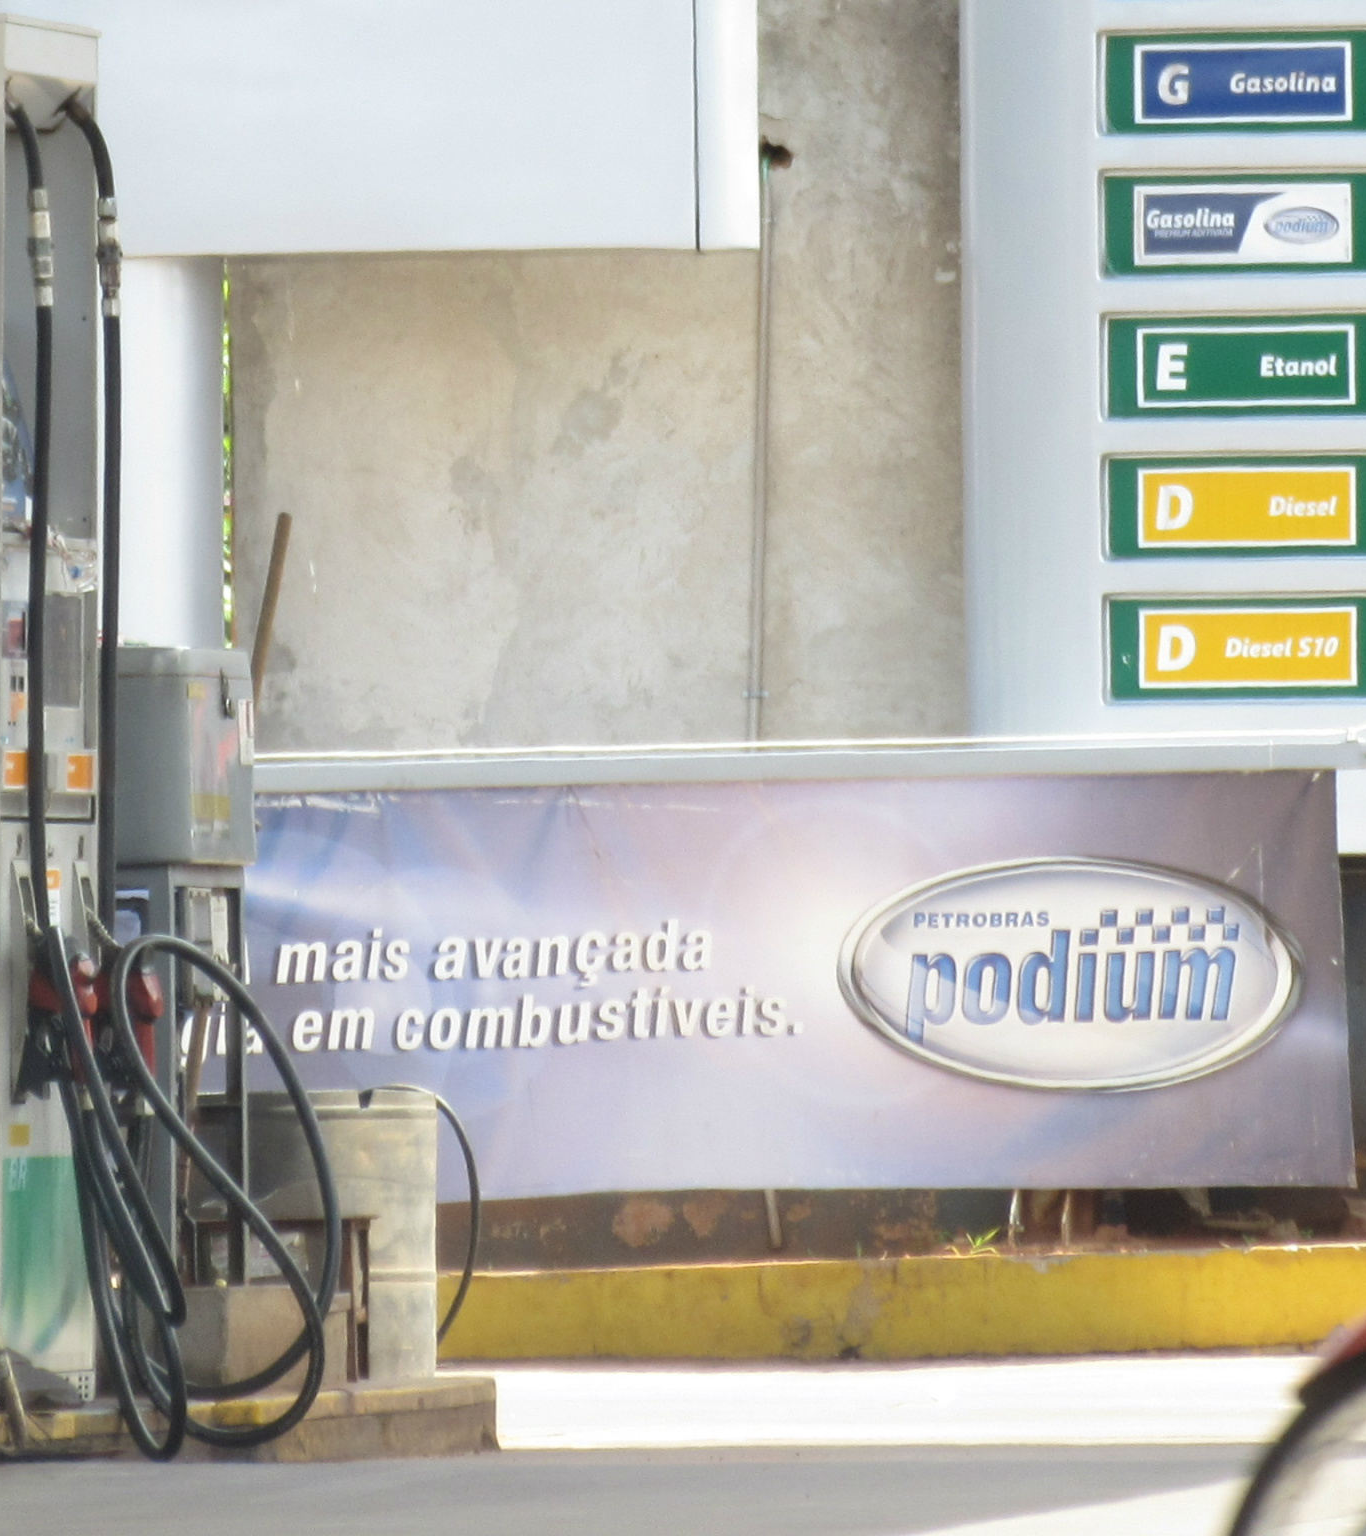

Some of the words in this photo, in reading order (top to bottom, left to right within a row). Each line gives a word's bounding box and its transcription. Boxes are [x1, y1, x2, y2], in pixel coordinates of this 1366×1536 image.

[1157, 64, 1190, 105] G
[1229, 70, 1337, 95] Gasolina
[1146, 207, 1235, 229] Gasolina
[1274, 214, 1329, 235] podium
[1156, 344, 1188, 390] E
[1260, 354, 1337, 378] Etanol
[1155, 485, 1194, 531] D
[1268, 496, 1337, 518] Diesel
[1156, 625, 1196, 671] D
[1224, 638, 1293, 660] Diesel
[1297, 637, 1339, 659] S10
[912, 910, 1050, 930] PETROBRAS
[275, 925, 411, 986] mais
[432, 919, 715, 991] avançada
[905, 924, 1238, 1044] podium
[292, 1006, 375, 1054] em
[394, 984, 806, 1051] combustíveis.
